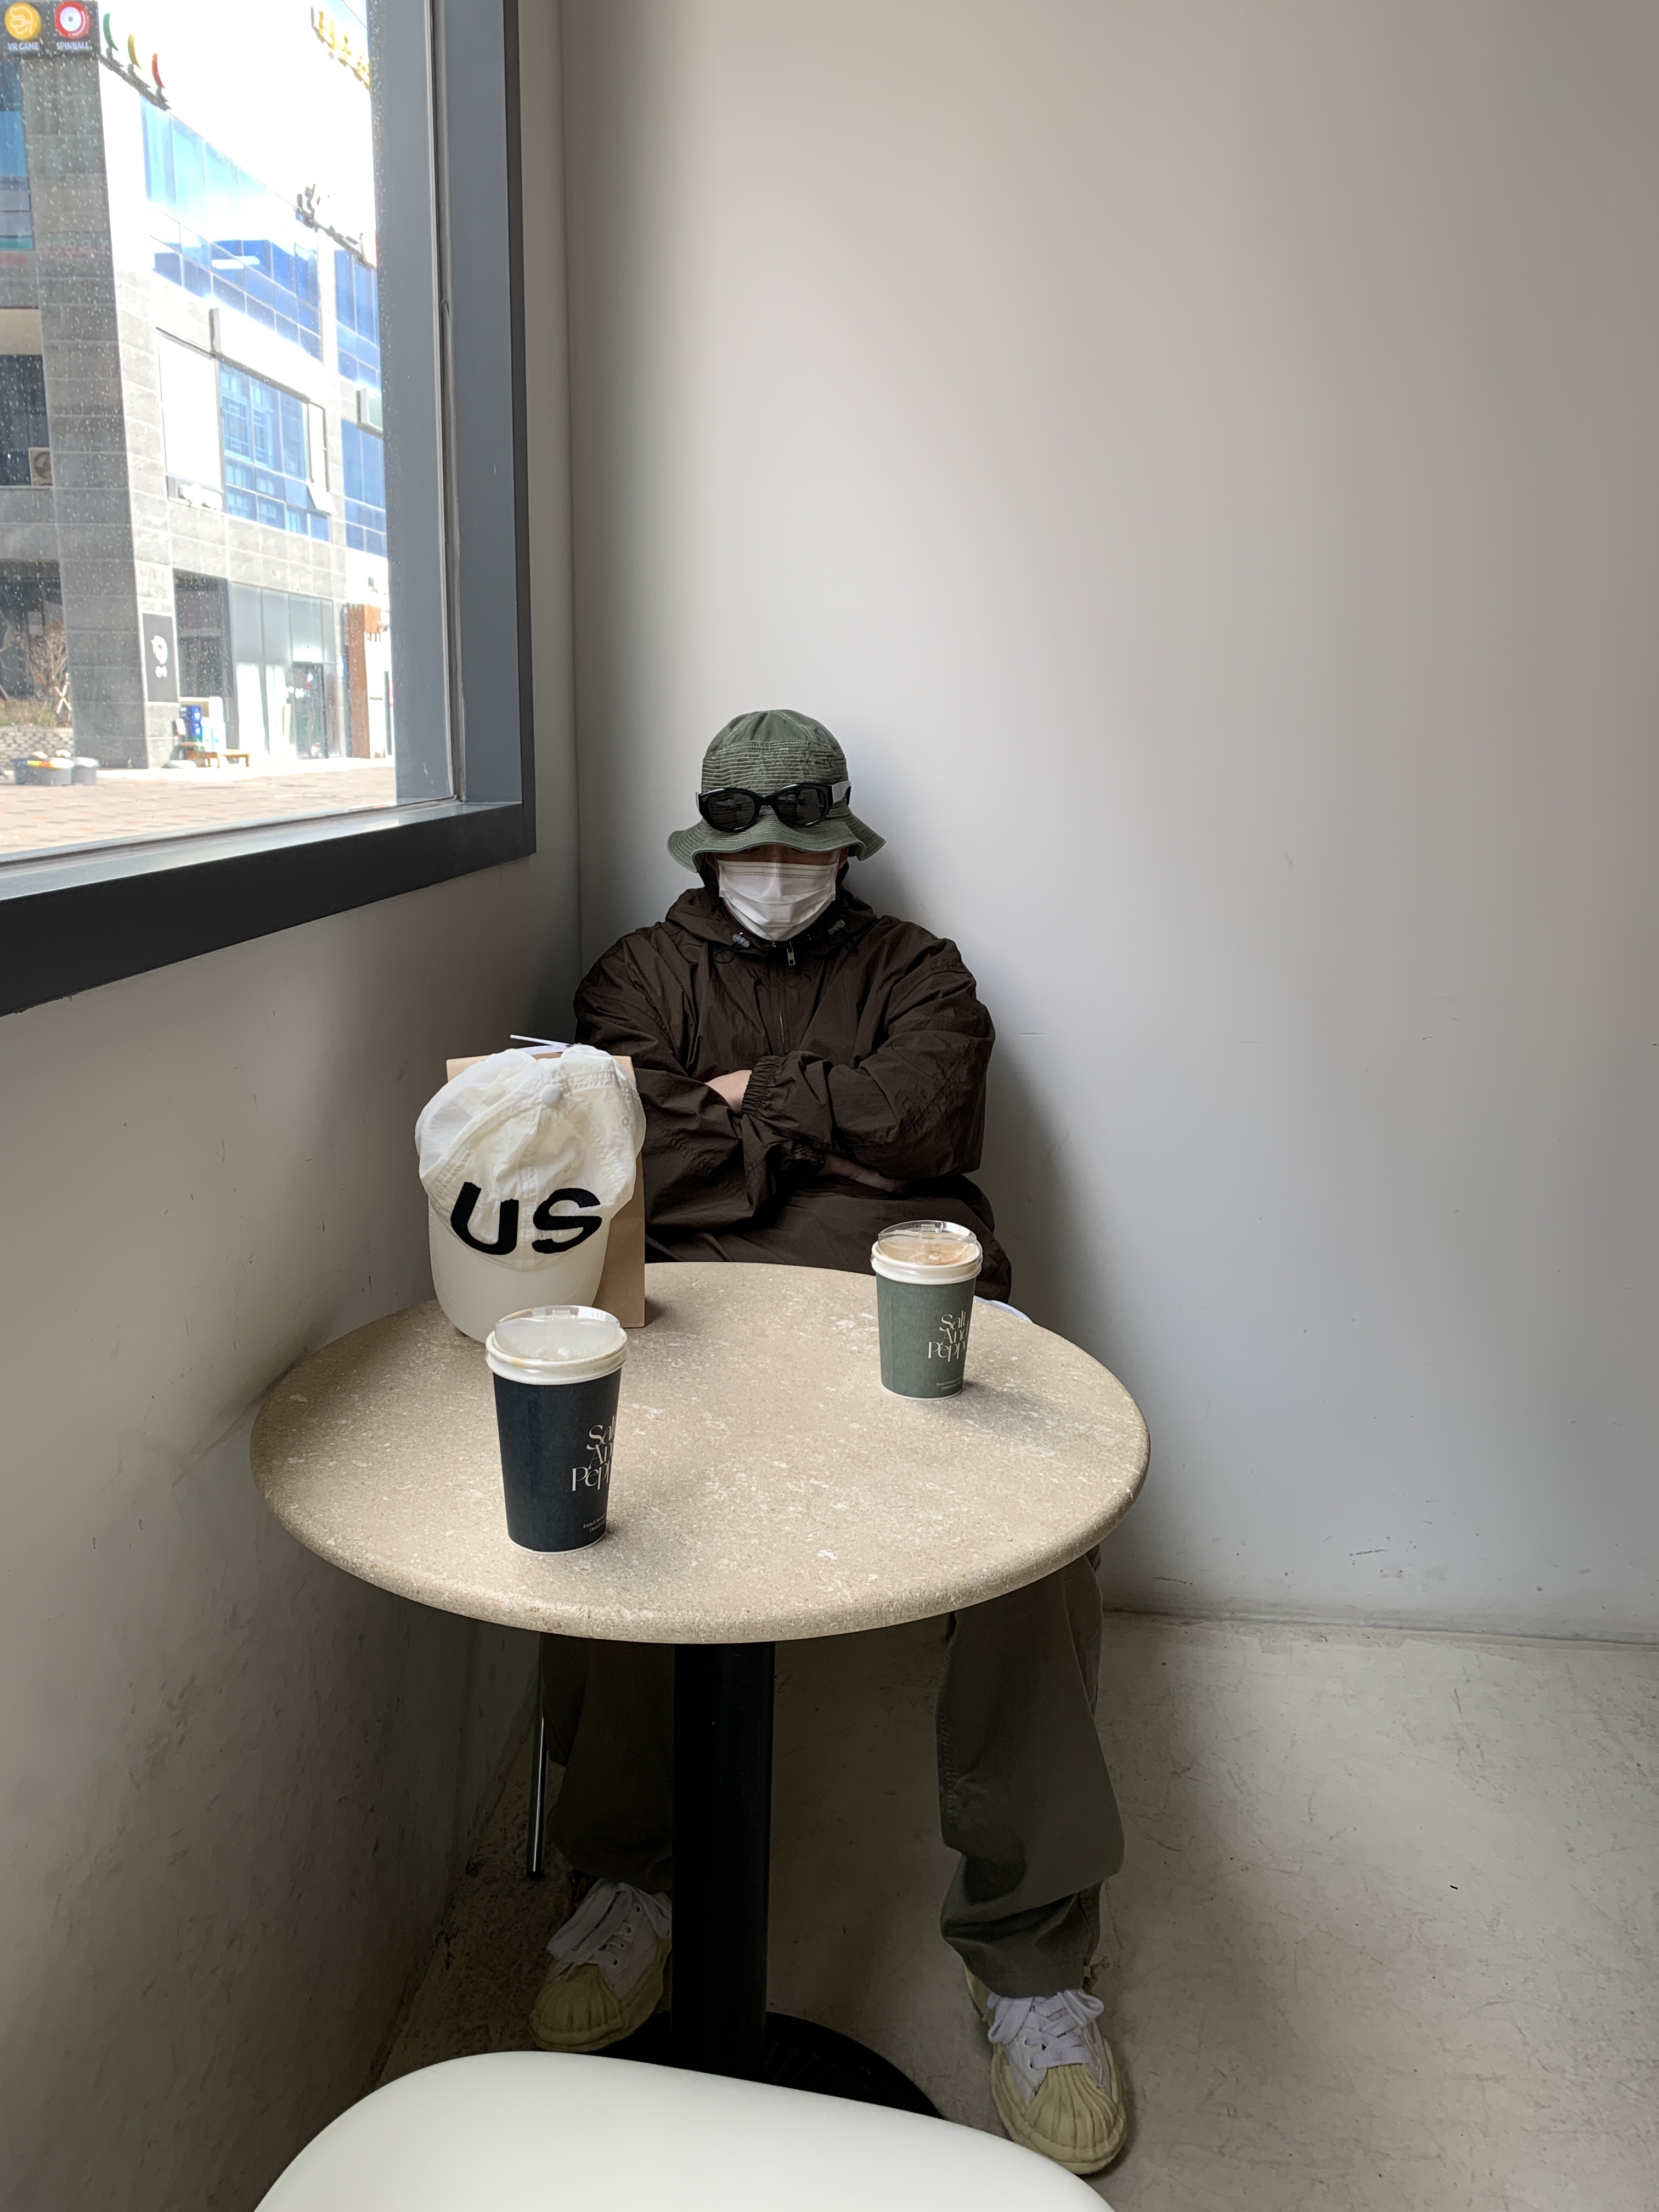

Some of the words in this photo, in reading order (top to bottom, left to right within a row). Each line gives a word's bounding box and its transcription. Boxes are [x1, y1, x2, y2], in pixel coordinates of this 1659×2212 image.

[7, 42, 18, 50] VR
[19, 42, 39, 50] GAME
[56, 41, 89, 49] SPINBALL
[450, 1182, 602, 1255] US
[940, 1320, 969, 1345] And
[588, 1442, 613, 1470] An
